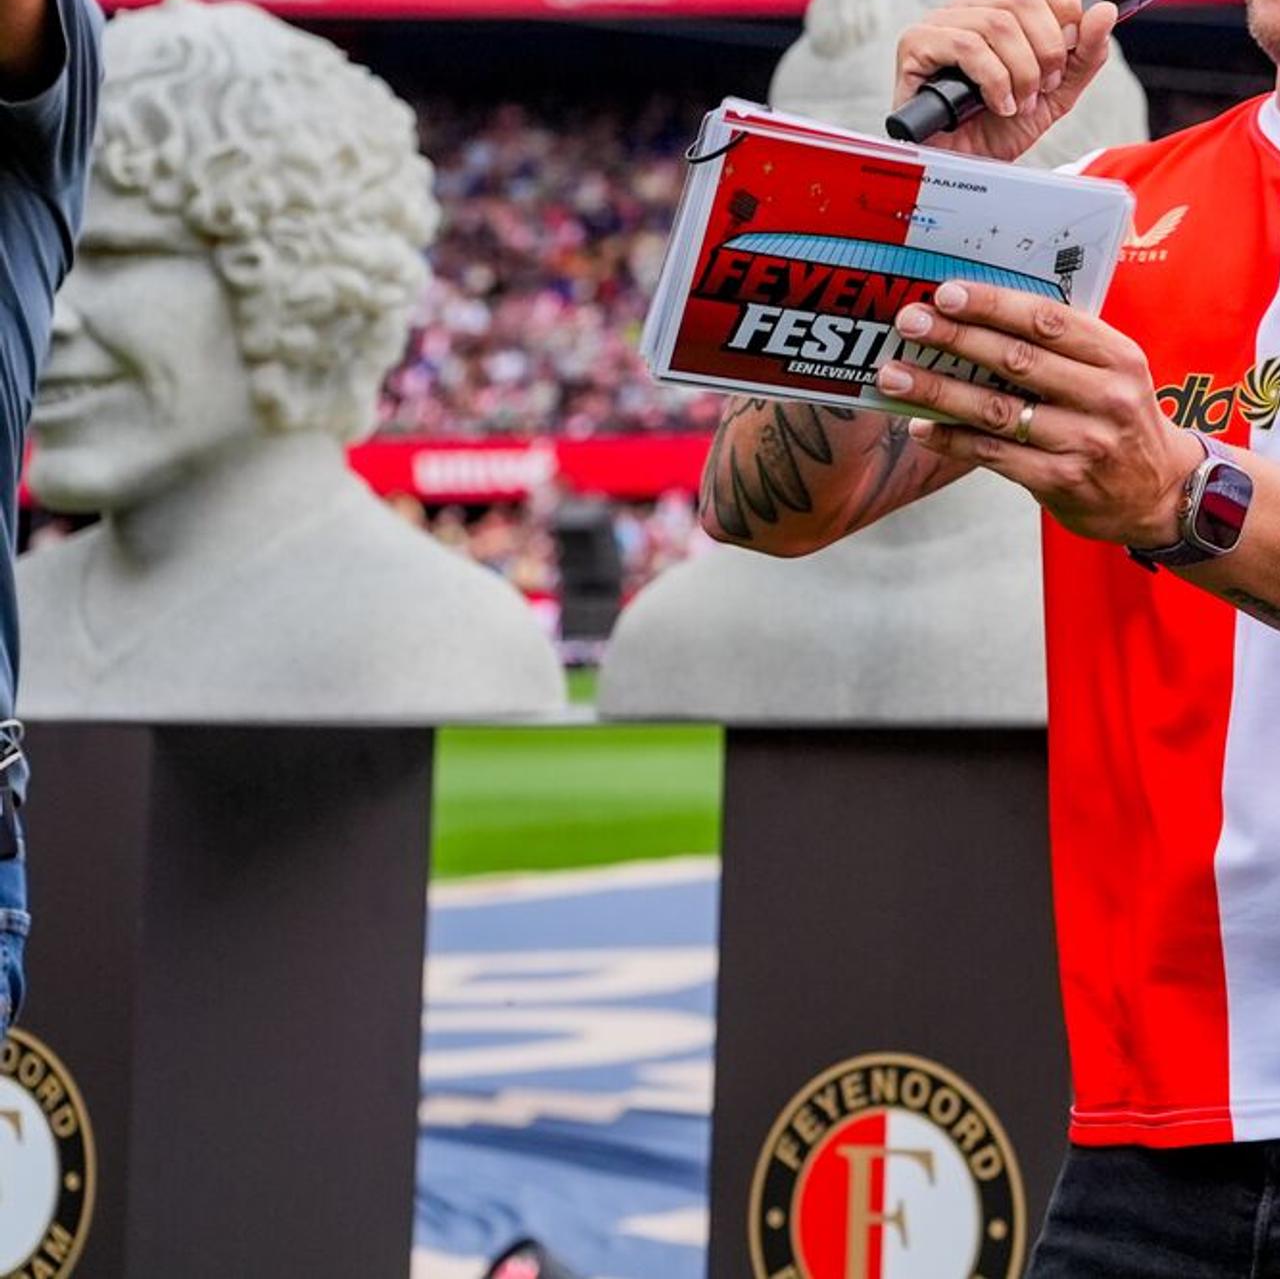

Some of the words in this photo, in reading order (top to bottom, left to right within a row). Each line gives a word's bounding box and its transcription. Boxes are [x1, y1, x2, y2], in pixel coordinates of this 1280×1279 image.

[787, 360, 815, 375] EEN
[813, 363, 856, 381] LEVEN
[774, 1068, 1003, 1182] FEYENOORD
